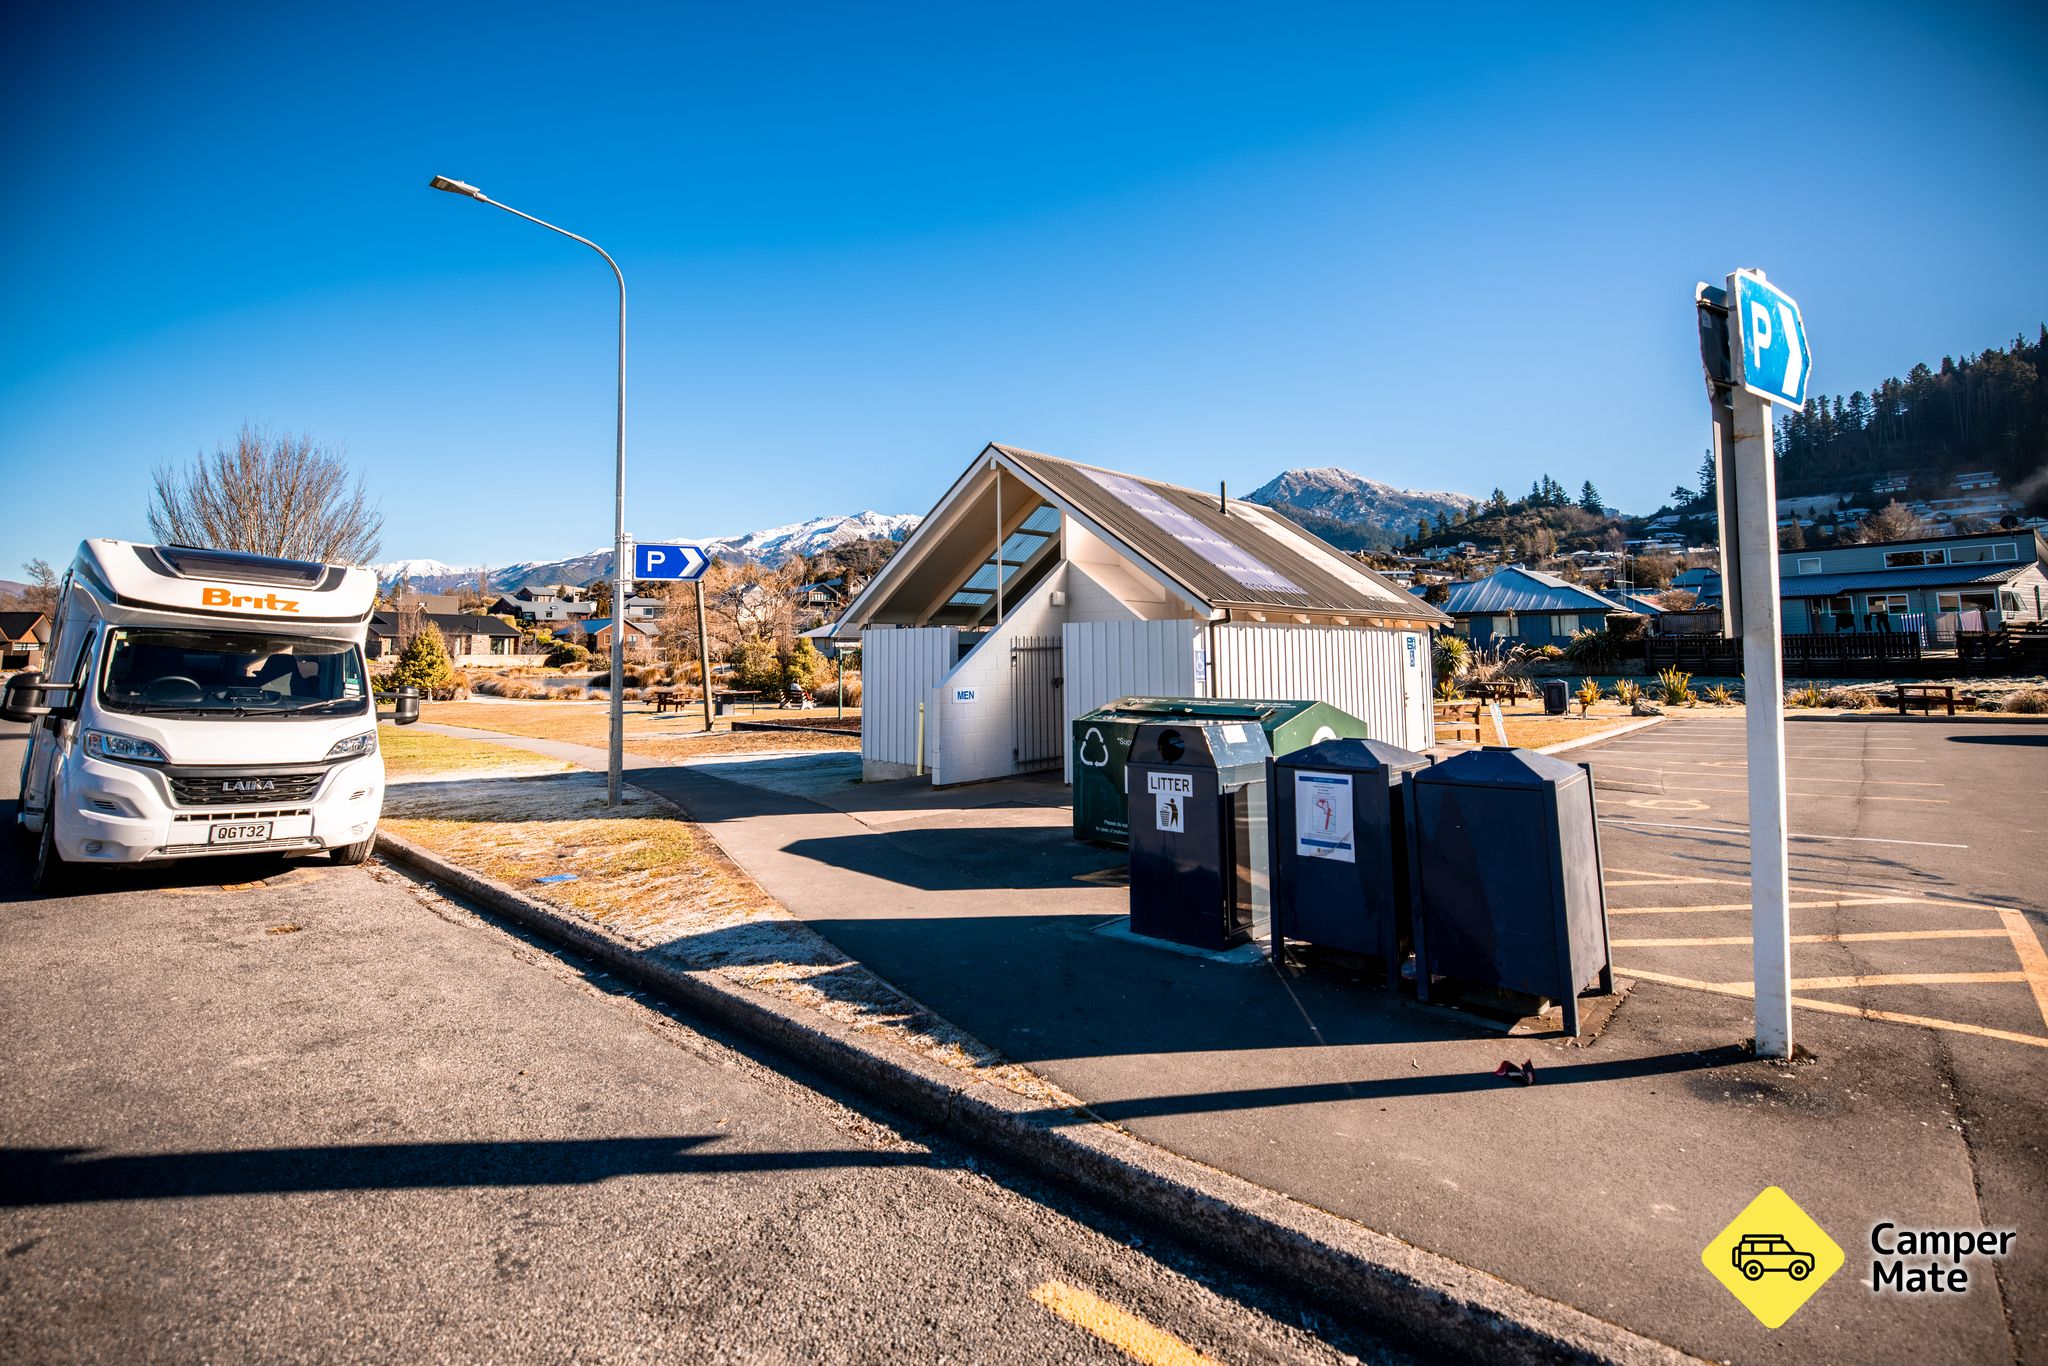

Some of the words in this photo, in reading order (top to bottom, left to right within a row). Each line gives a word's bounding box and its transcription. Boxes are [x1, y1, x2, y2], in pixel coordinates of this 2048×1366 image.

[1750, 300, 1773, 368] P
[647, 550, 666, 572] P
[202, 587, 300, 613] Britz
[957, 690, 975, 700] MEN
[222, 780, 275, 792] LAIKA
[1150, 776, 1190, 792] LITTER
[218, 825, 265, 839] QGT32
